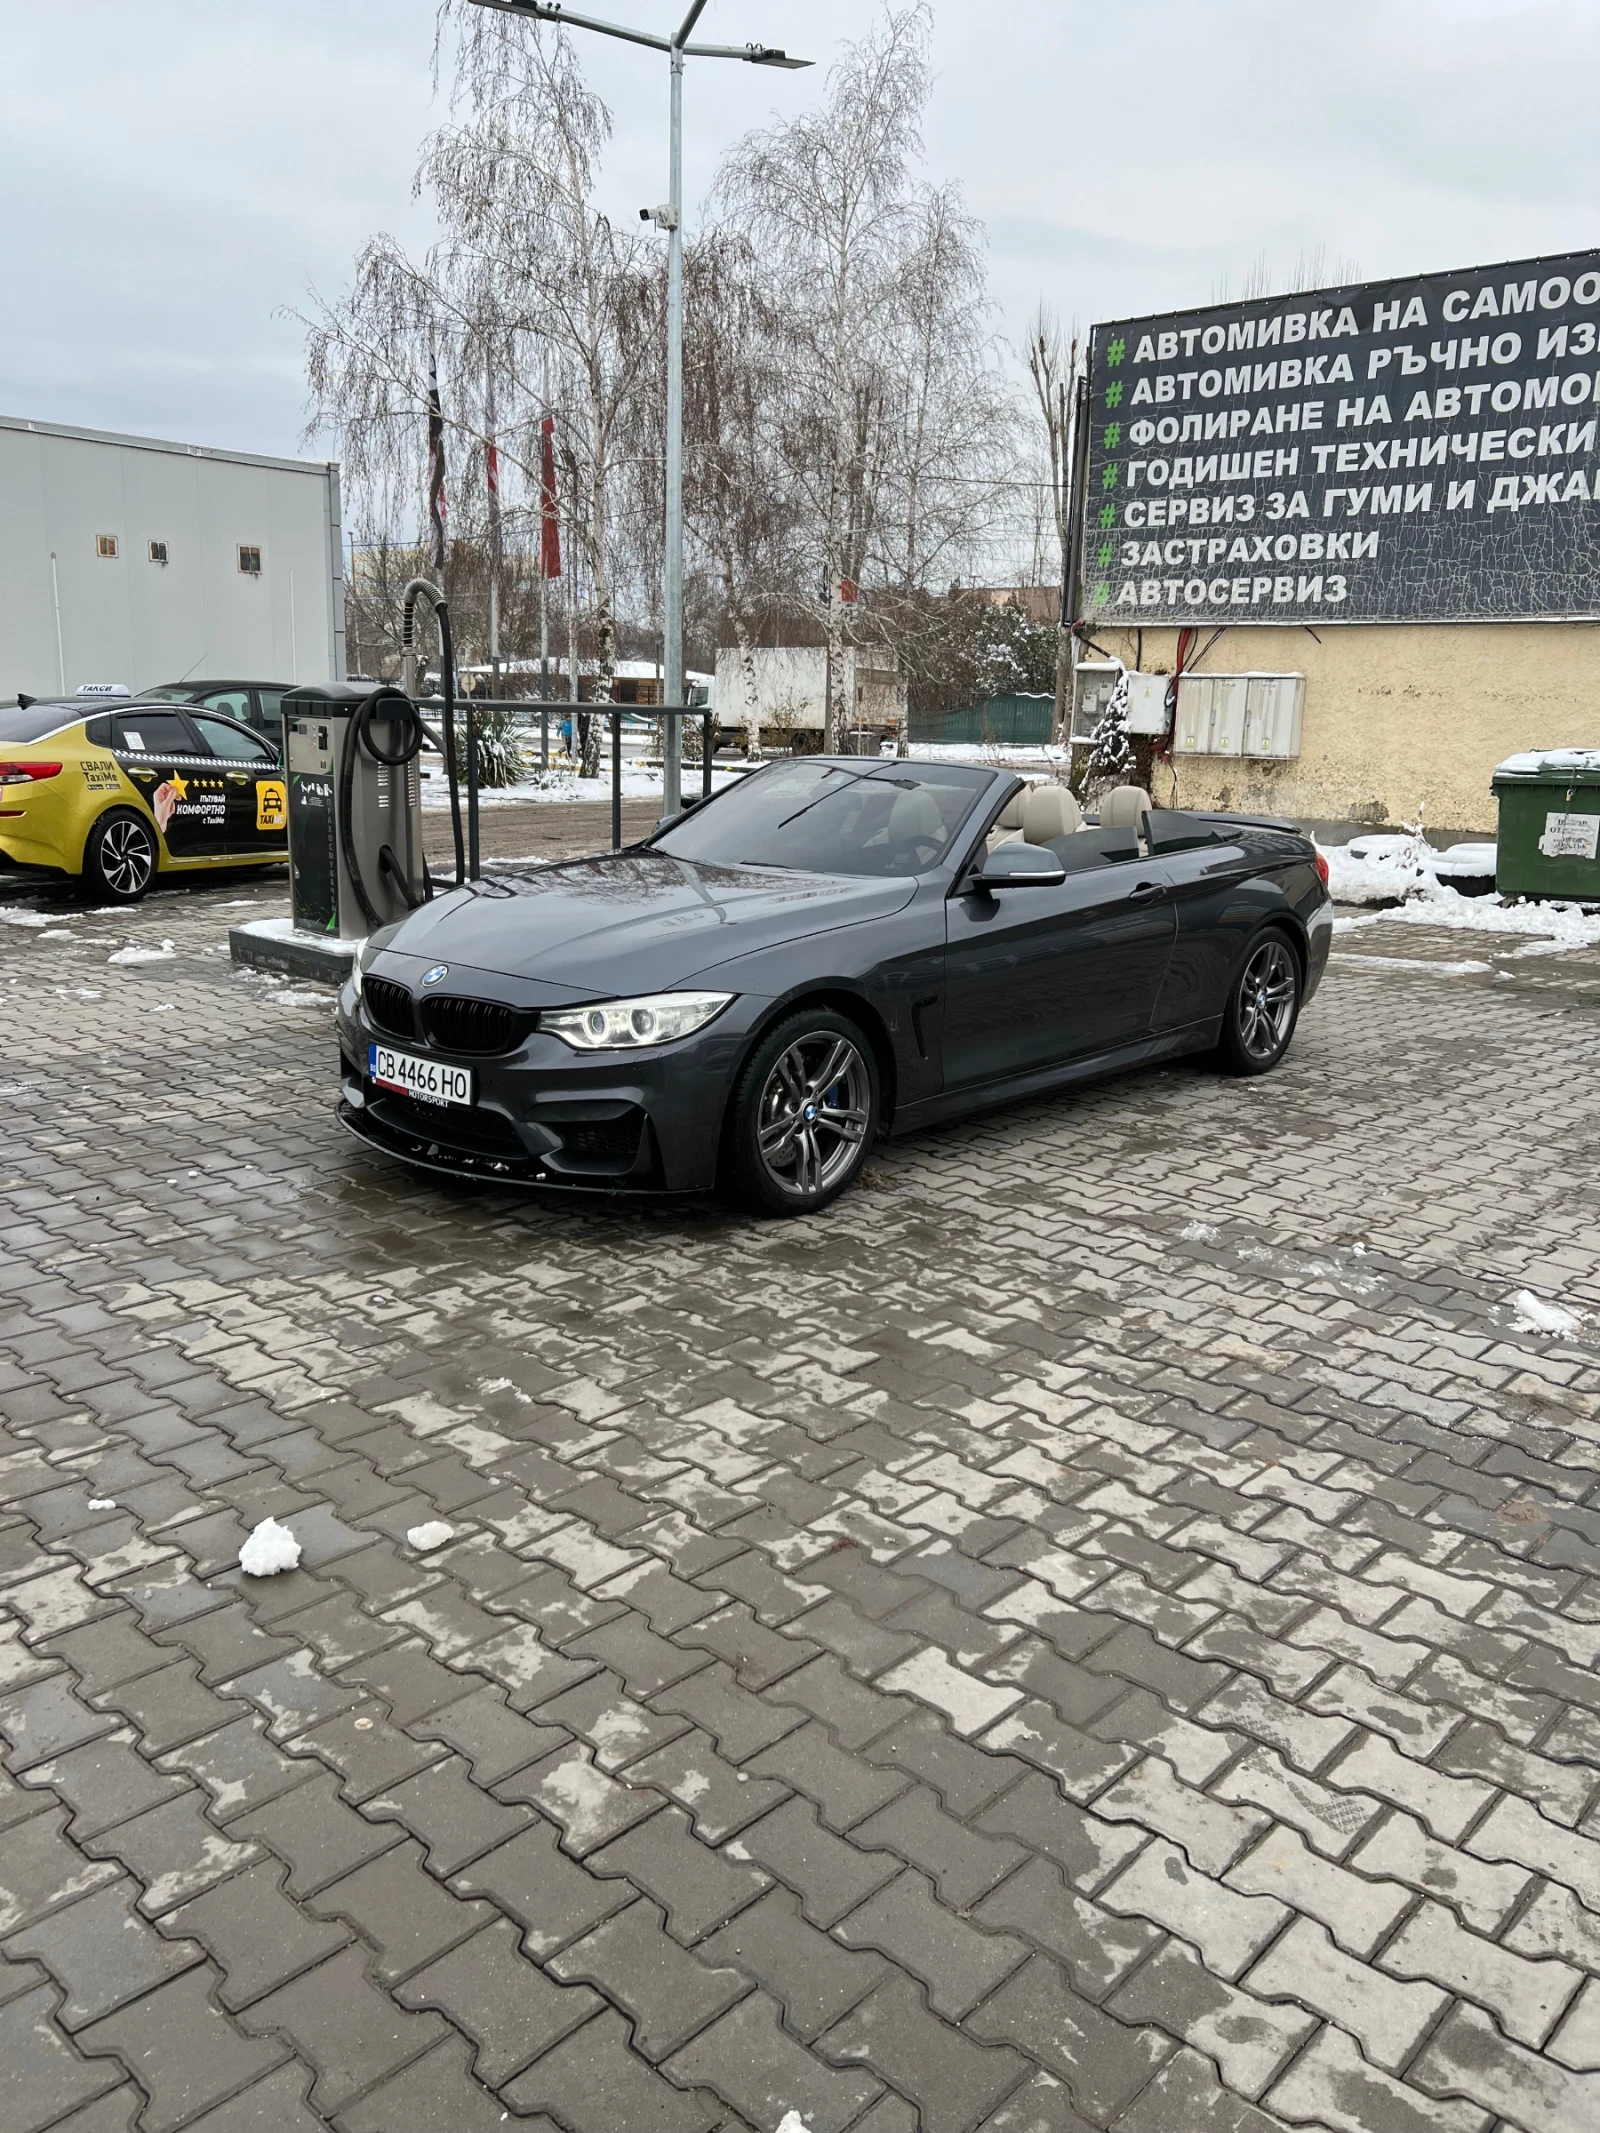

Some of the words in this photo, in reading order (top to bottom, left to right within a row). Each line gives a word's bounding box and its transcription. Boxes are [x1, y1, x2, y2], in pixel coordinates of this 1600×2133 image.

[1107, 339, 1125, 367] #
[1133, 307, 1359, 363] АВТОМИВКА
[1372, 296, 1428, 333] НА
[1105, 381, 1123, 408] #
[1130, 353, 1354, 406] АВТОМИВКА
[1367, 332, 1522, 379] РЪЧНО
[1536, 322, 1600, 360] ИЗ
[1104, 422, 1120, 449] #
[1129, 401, 1324, 446] ФОЛИРАНЕ
[1336, 395, 1392, 428] НА
[1102, 463, 1118, 489] #
[1127, 448, 1299, 490] ГОДИШЕН
[1311, 420, 1597, 474] ТЕХНИЧЕСКИ
[1101, 503, 1116, 529] #
[1124, 494, 1255, 528] СЕРВИЗ
[1265, 490, 1310, 520] ЗА
[1323, 482, 1433, 517] ГУМИ
[1446, 479, 1476, 510] И
[1121, 531, 1379, 567] ЗАСТРАХОВКИ
[1116, 575, 1347, 606] АВТОСЕРВИЗ
[80, 761, 115, 772] СВАЛИ
[83, 772, 118, 782] TaxiMe
[176, 804, 226, 815] КОМФОРТНО
[200, 794, 226, 803] ПЪТУВАЙ
[398, 1057, 438, 1092] 4466
[408, 1089, 449, 1108] MOTORSPORT
